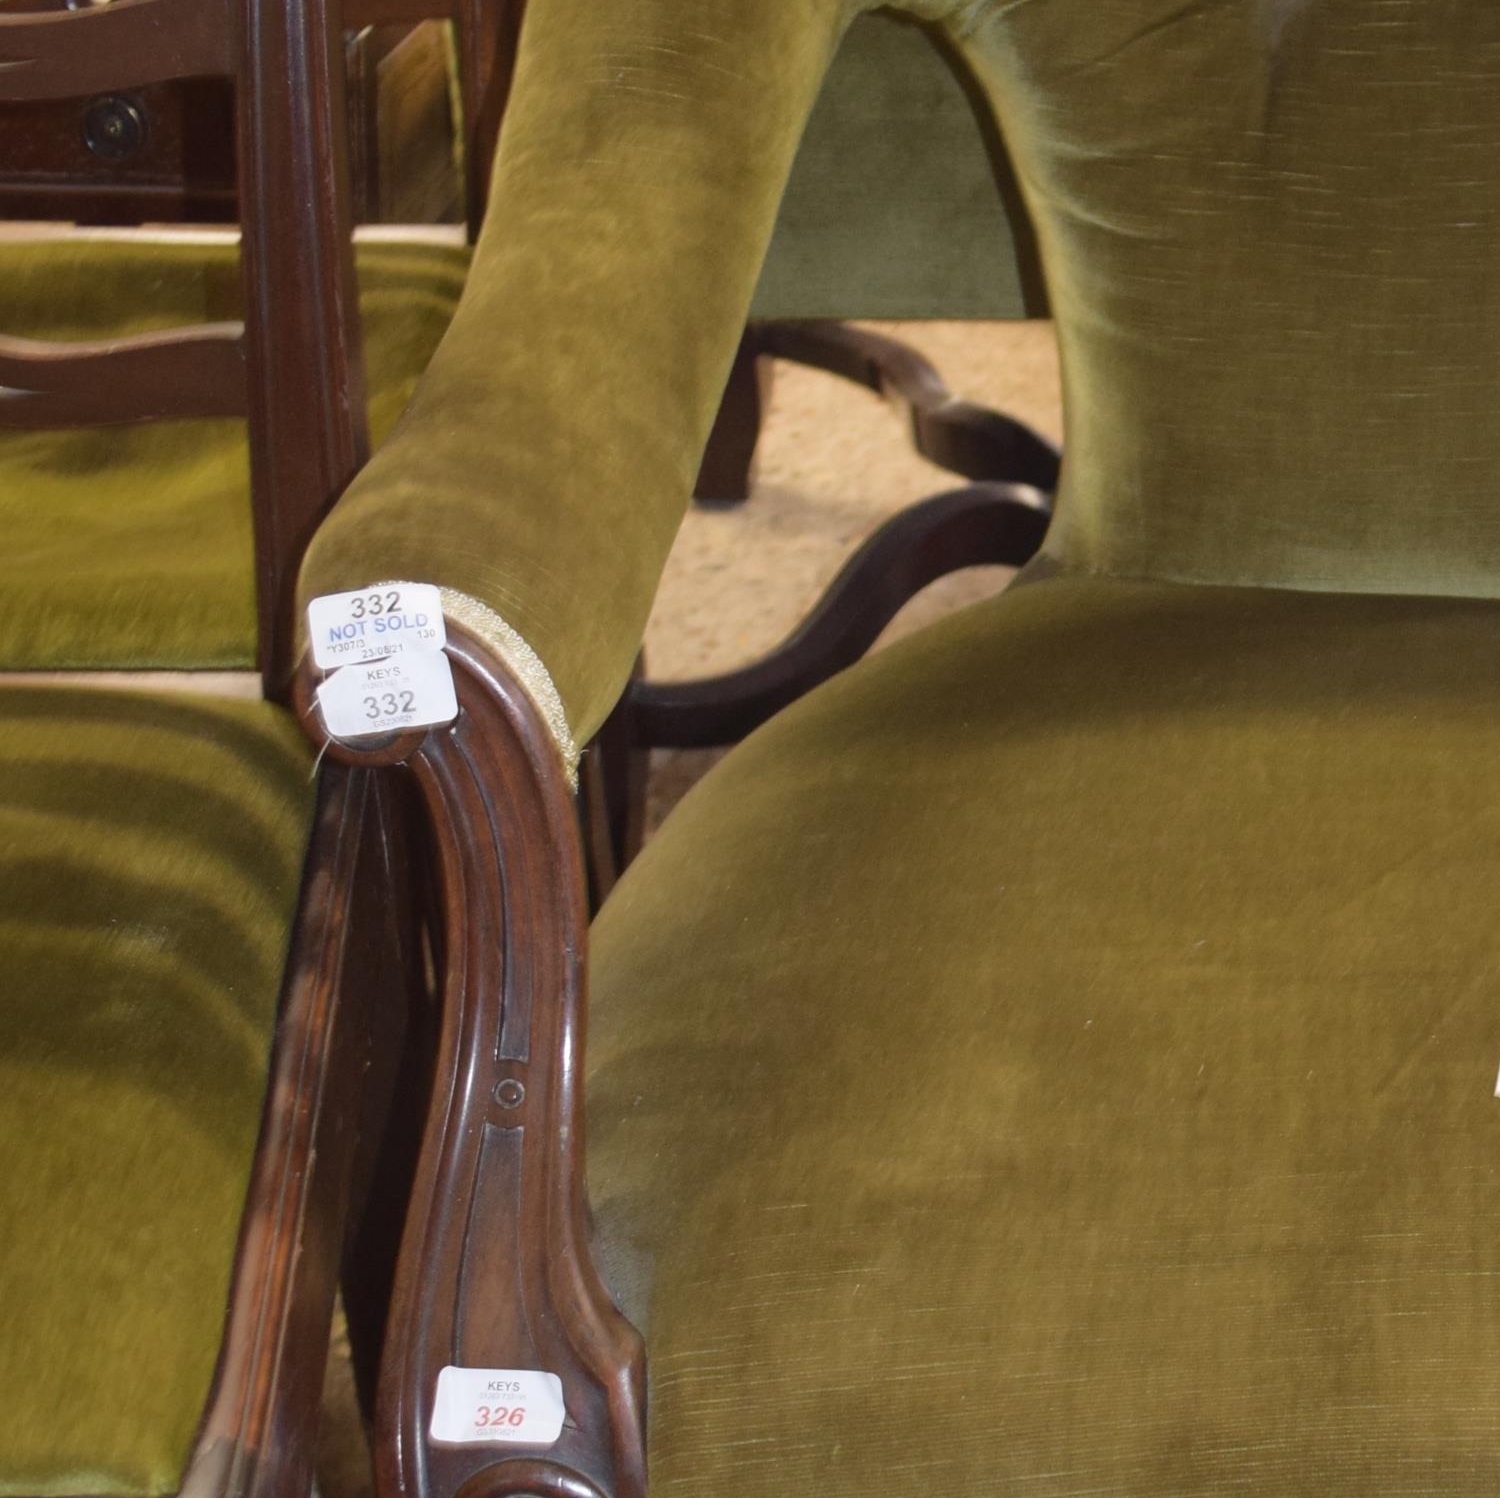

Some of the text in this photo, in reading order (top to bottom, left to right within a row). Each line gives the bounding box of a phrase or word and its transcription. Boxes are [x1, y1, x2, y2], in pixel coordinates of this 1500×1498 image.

[350, 591, 402, 619] 332
[329, 613, 429, 642] NOT SOLD
[418, 628, 436, 639] 130
[367, 666, 401, 681] KEYS
[363, 690, 417, 719] 332
[487, 1380, 521, 1392] KEYS
[475, 1405, 527, 1428] 326
